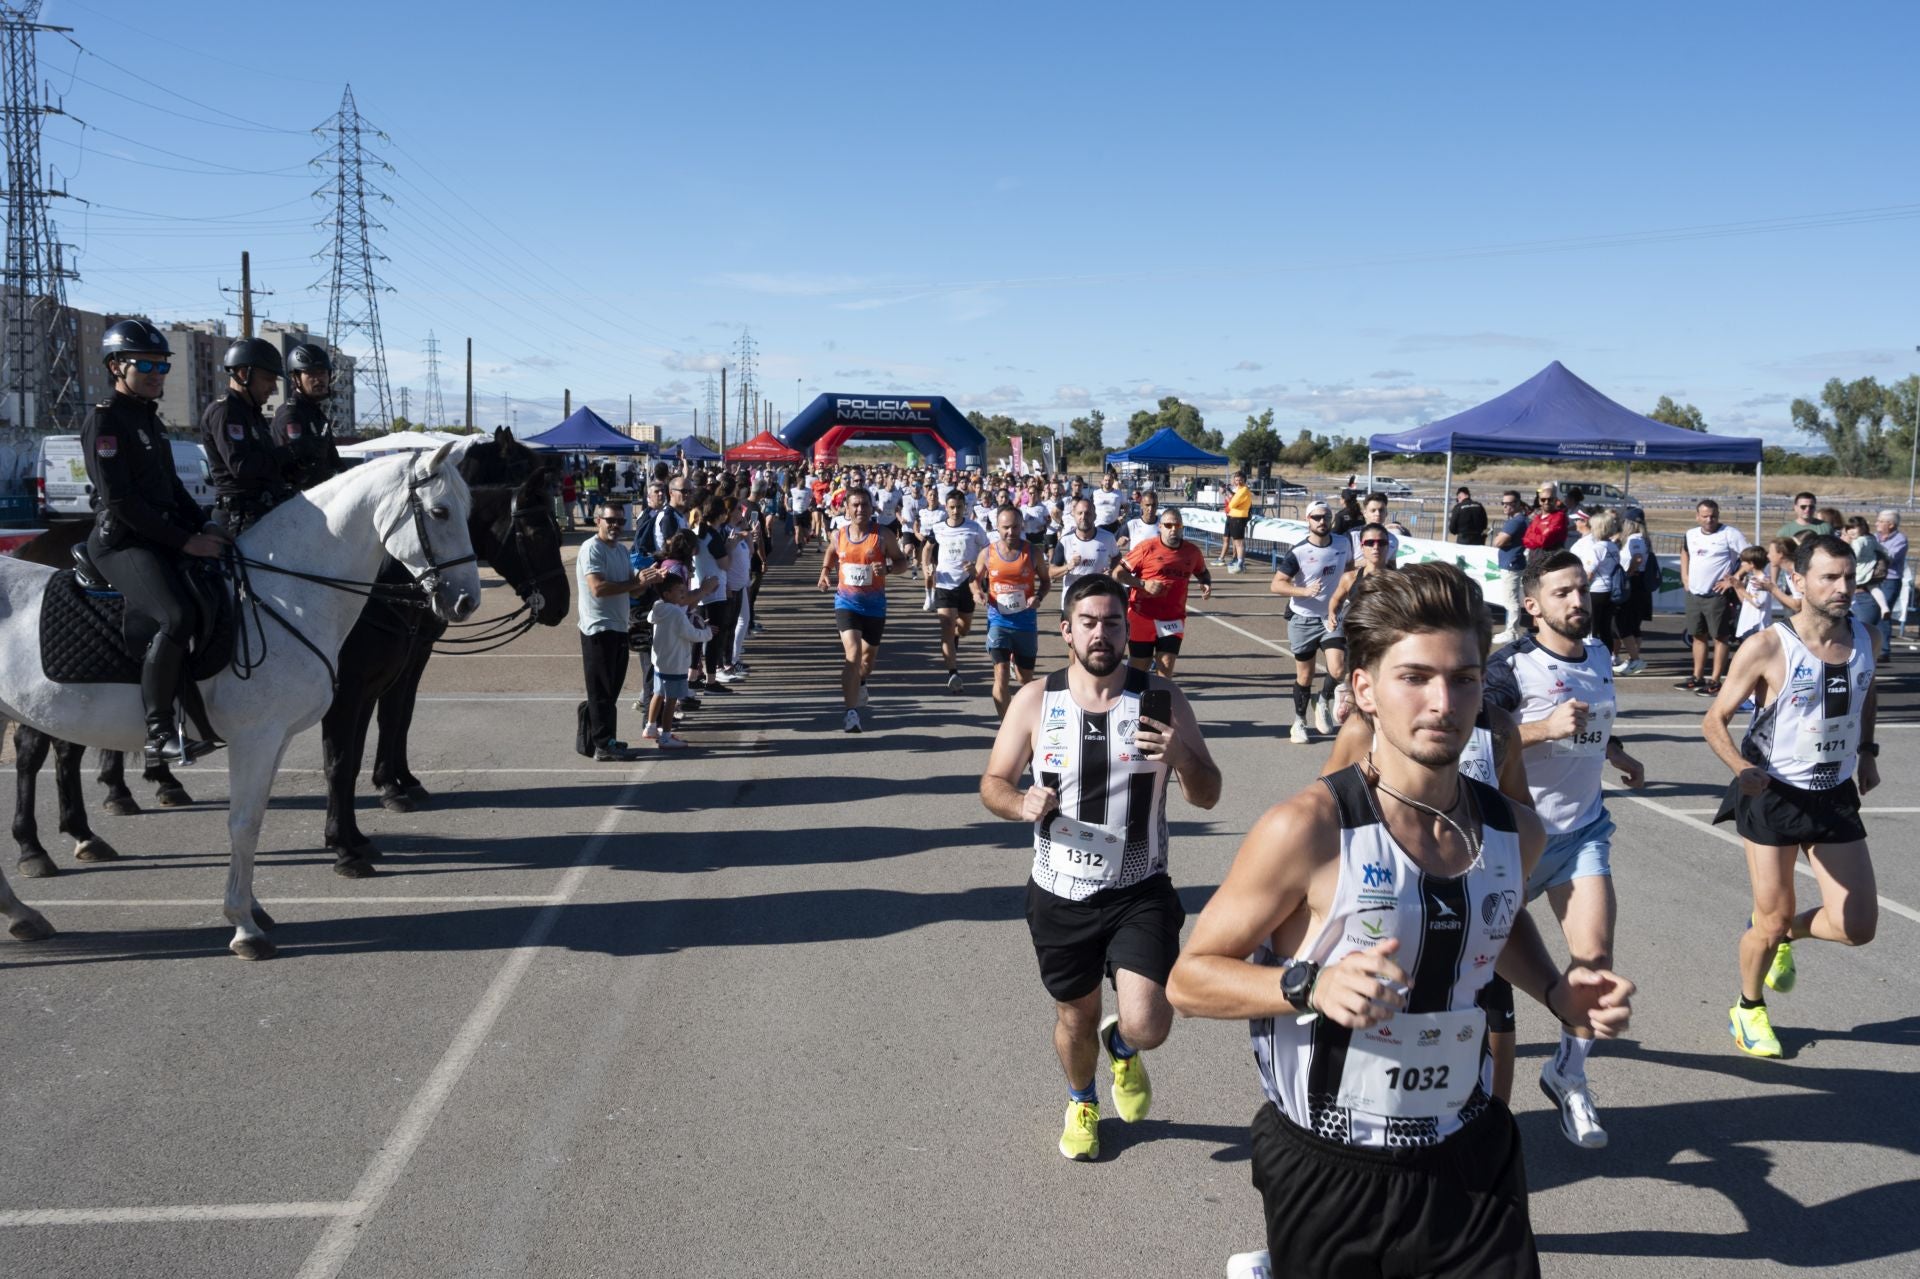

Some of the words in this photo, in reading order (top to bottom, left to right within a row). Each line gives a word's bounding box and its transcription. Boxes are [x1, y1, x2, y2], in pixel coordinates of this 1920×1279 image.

[836, 398, 912, 410] POLICIA
[836, 409, 931, 421] NACIONAL
[1572, 730, 1603, 745] 1543
[1814, 739, 1846, 752] 1471
[1066, 848, 1104, 867] 1312
[1346, 934, 1377, 947] Extrem
[1363, 1031, 1403, 1046] Santander
[1385, 1064, 1450, 1091] 1032
